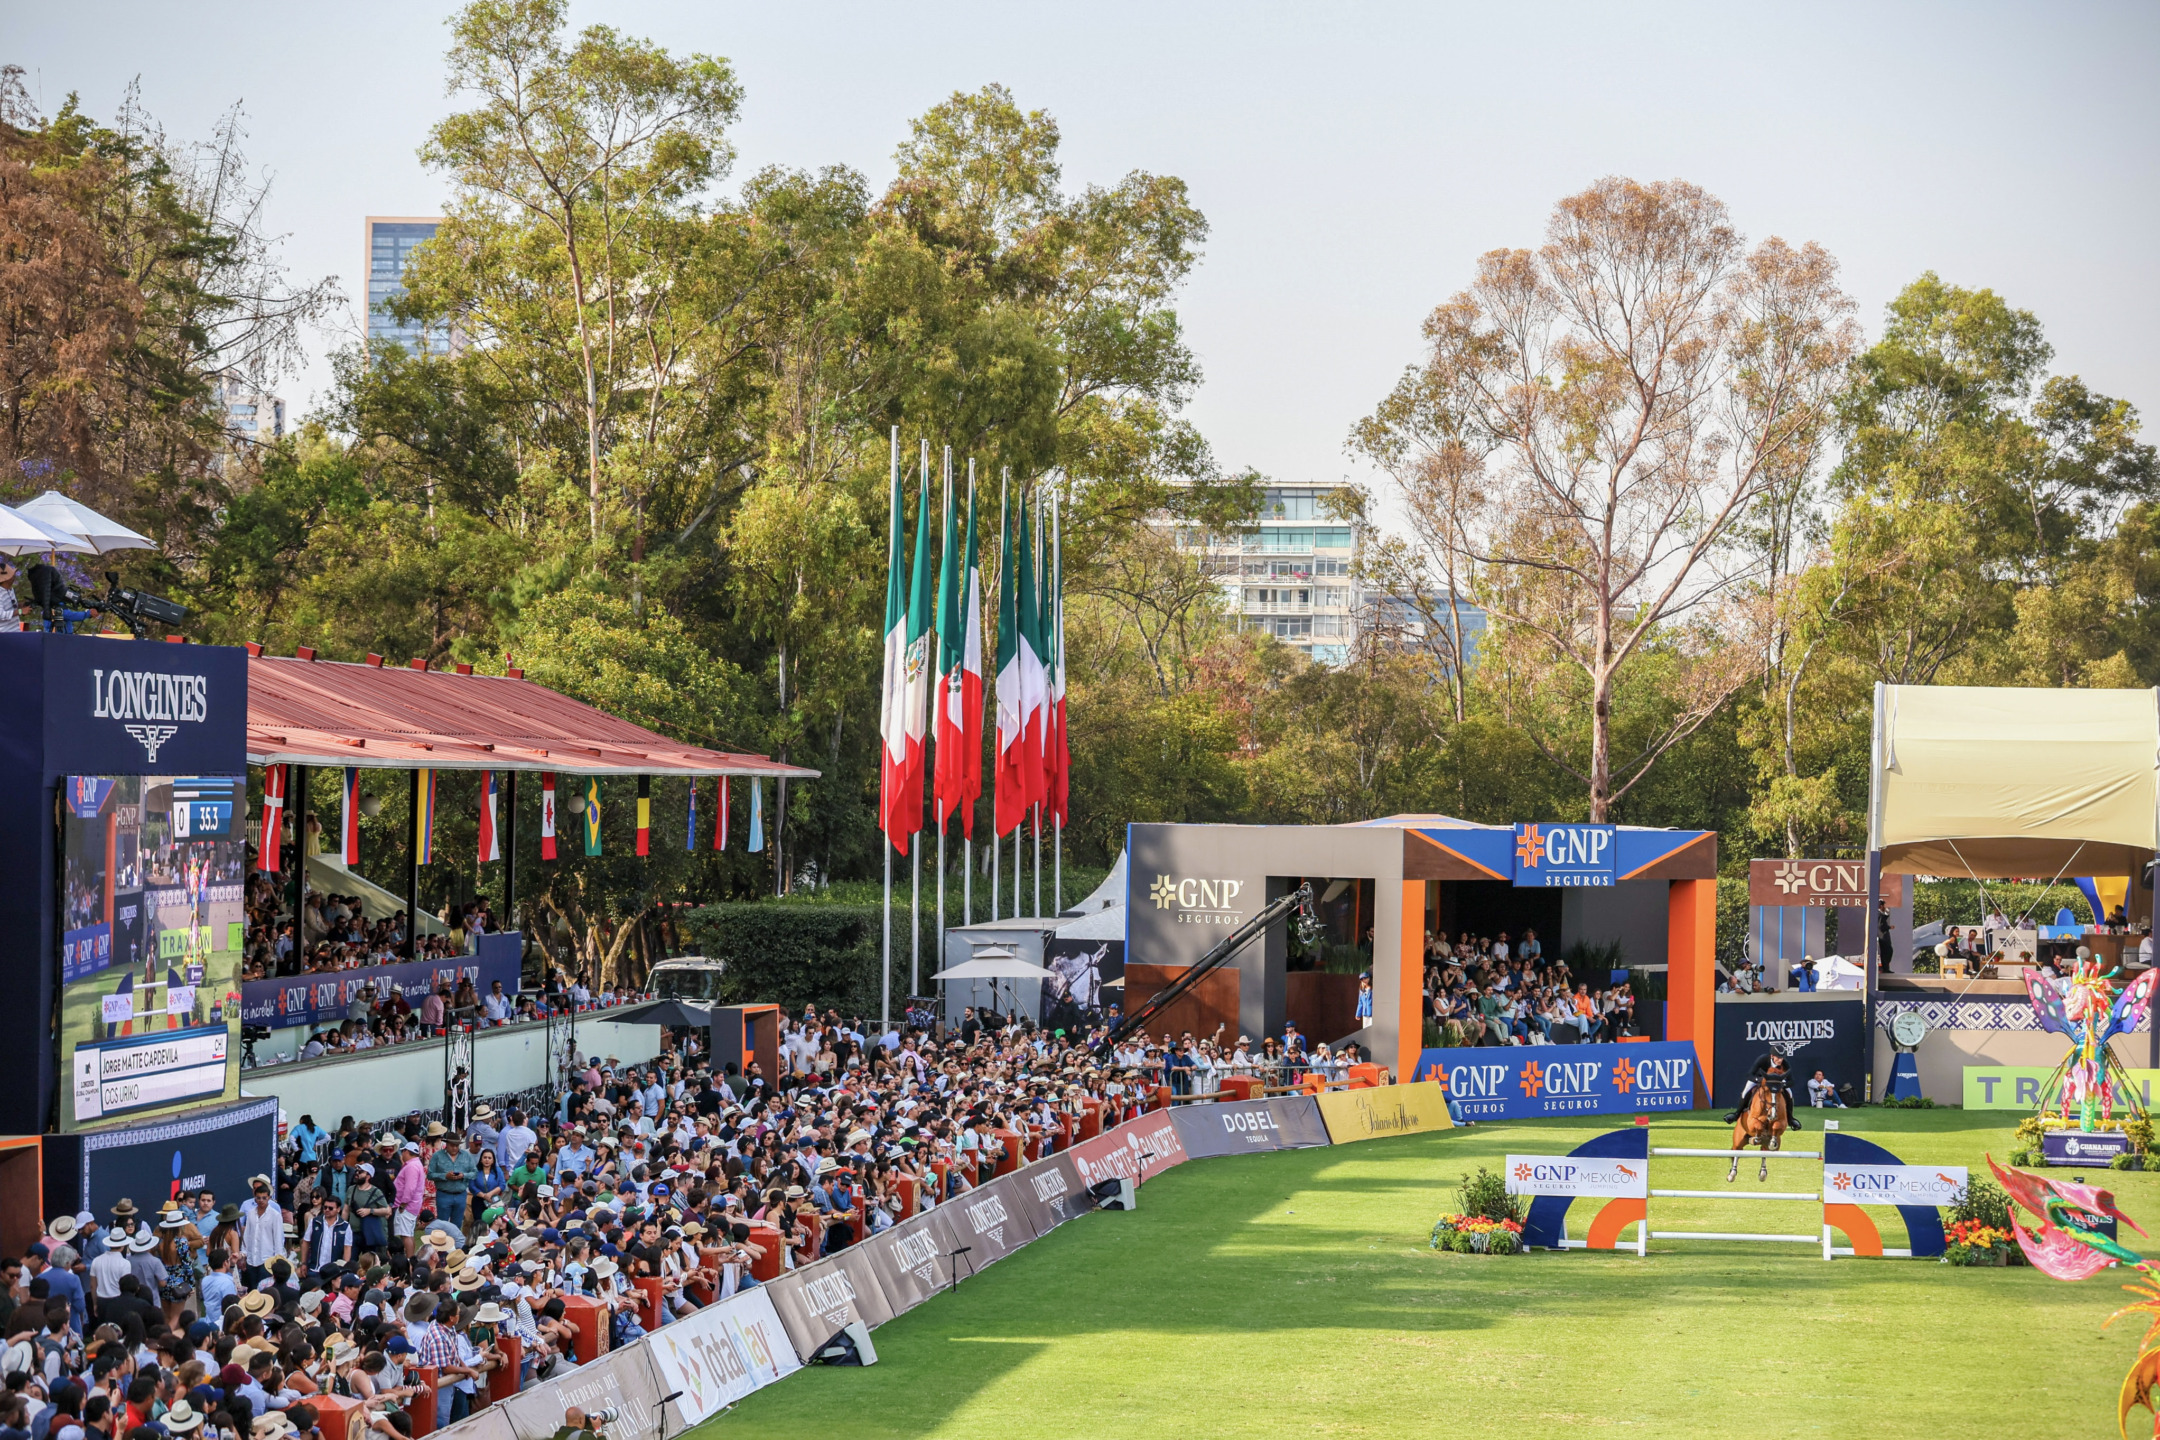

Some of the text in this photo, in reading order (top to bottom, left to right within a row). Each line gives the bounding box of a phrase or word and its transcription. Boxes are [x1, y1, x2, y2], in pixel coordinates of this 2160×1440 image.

[94, 669, 207, 723] LONGINES
[83, 777, 97, 802] GNP
[120, 807, 136, 826] GNP
[179, 808, 184, 832] 0
[200, 806, 218, 831] 35.3
[1546, 828, 1608, 865] GNP
[1178, 878, 1240, 908] GNP
[1546, 876, 1608, 886] SEGUROS
[1809, 898, 1879, 906] SEGUR
[1178, 914, 1240, 924] SEGUROS
[80, 938, 92, 962] GNP
[98, 934, 110, 956] GNP
[162, 933, 210, 954] TRAXN
[286, 987, 306, 1012] GNP
[318, 982, 337, 1008] GNP
[1746, 1020, 1834, 1041] LONGINES
[102, 1048, 178, 1075] JORGE MATTE CAPDEVILA
[1450, 1066, 1505, 1098] GNP
[1544, 1062, 1598, 1094] GNP
[1636, 1059, 1688, 1090] GNP
[104, 1084, 139, 1106] CCS URIKO
[1544, 1099, 1598, 1110] SEGUROS
[1636, 1096, 1688, 1106] SEGUROS
[1460, 1104, 1504, 1114] GUROS
[1222, 1110, 1279, 1133] DOBEL
[1246, 1134, 1269, 1144] TEQUILA
[2080, 1144, 2120, 1152] GUANAJUATO
[1090, 1146, 1138, 1183] BANORTE
[1534, 1164, 1631, 1184] GNP MEXICO
[182, 1174, 206, 1190] IMAGEN
[1030, 1166, 1068, 1203] LONGINES
[1853, 1174, 1950, 1192] GNP MEXICO
[964, 1194, 1008, 1234] LONGINES
[890, 1227, 939, 1274] LONGINES
[798, 1268, 857, 1318] LONGINES
[691, 1315, 779, 1386] Totalplay
[556, 1372, 620, 1411] HEREDEROS DEL
